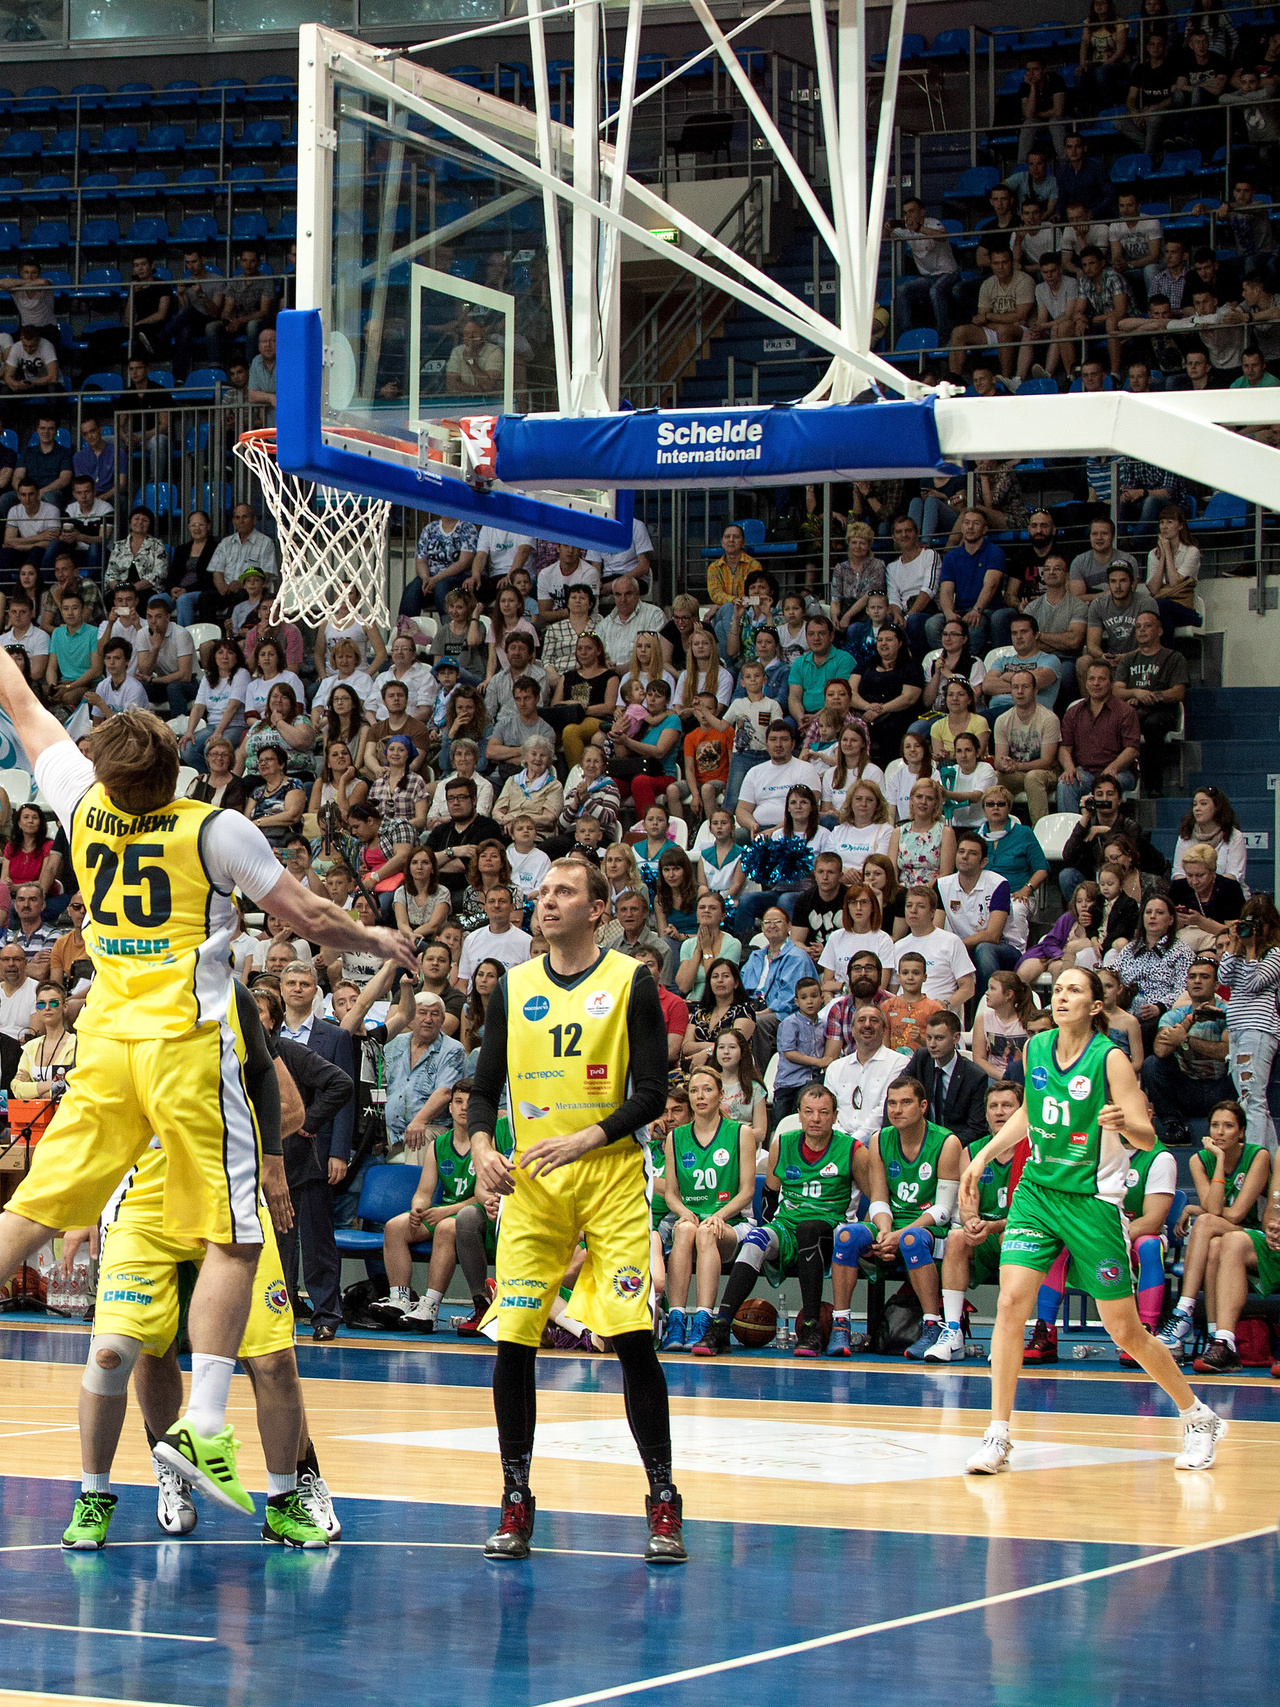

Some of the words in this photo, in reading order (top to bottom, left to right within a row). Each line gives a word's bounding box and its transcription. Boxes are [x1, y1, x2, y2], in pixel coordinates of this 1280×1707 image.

[657, 419, 763, 446] Schelde
[657, 445, 761, 464] International
[86, 806, 179, 837] БУЛЫКИН
[86, 842, 171, 928] 25
[97, 935, 170, 955] СИБУР
[548, 1022, 583, 1058] 12
[525, 1069, 564, 1080] астерос
[1042, 1096, 1070, 1126] 61
[692, 1168, 717, 1190] 20
[801, 1181, 822, 1198] 10
[897, 1181, 919, 1203] 62
[507, 1278, 548, 1290] астерос
[103, 1290, 153, 1307] СИБУР
[499, 1296, 543, 1309] СИБУР
